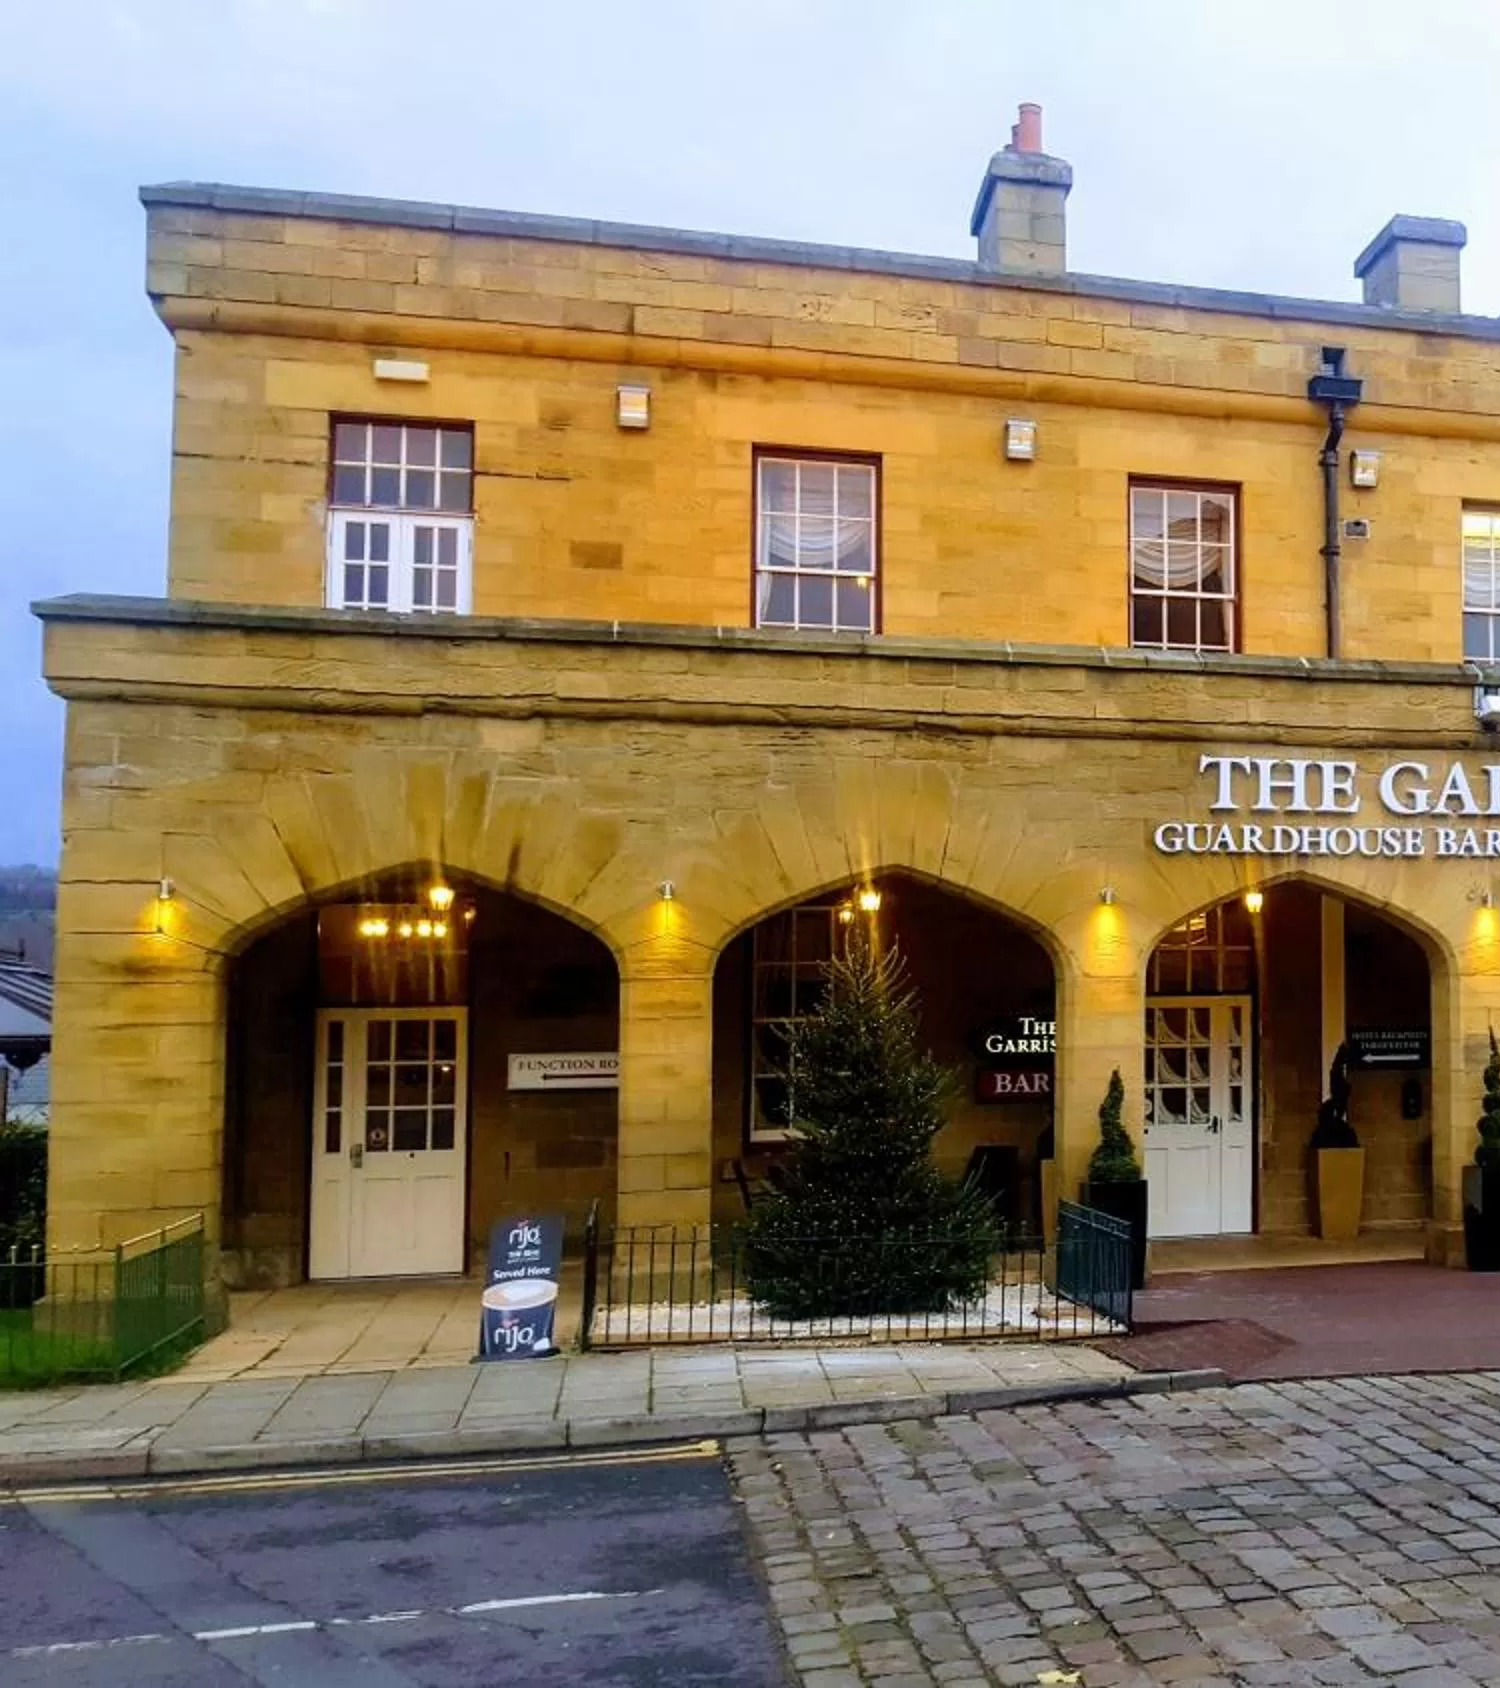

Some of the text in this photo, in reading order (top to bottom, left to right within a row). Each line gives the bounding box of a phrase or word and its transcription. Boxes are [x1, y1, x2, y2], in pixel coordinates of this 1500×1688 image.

[1199, 754, 1361, 813] THE
[1154, 823, 1425, 857] GUARDHOUSE
[1018, 1017, 1056, 1035] THE
[517, 1059, 595, 1071] FUNCTION
[994, 1072, 1049, 1093] BAR
[493, 1266, 551, 1279] Served Here
